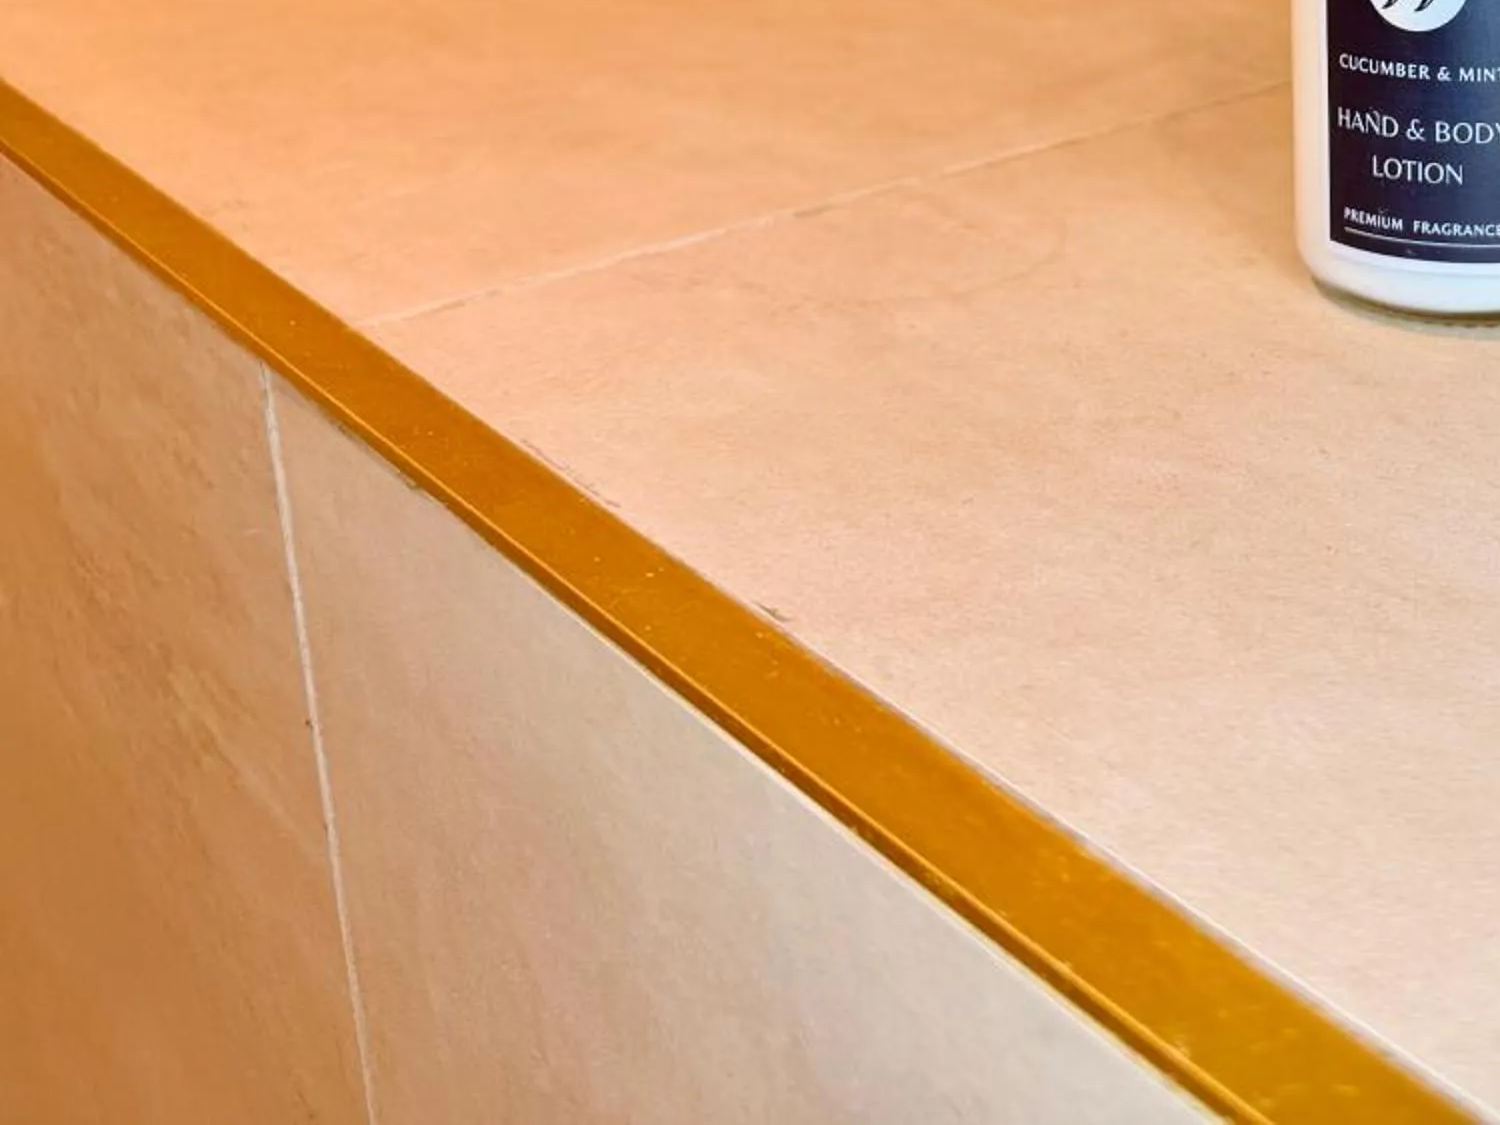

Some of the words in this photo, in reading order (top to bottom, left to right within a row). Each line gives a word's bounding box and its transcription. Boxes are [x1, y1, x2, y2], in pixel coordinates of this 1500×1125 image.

[1340, 54, 1430, 79] CUCUMBER
[1437, 67, 1451, 81] &
[1339, 107, 1398, 137] HAND
[1406, 119, 1424, 140] &
[1373, 155, 1462, 184] LOTION
[1344, 207, 1403, 231] PREMIUM
